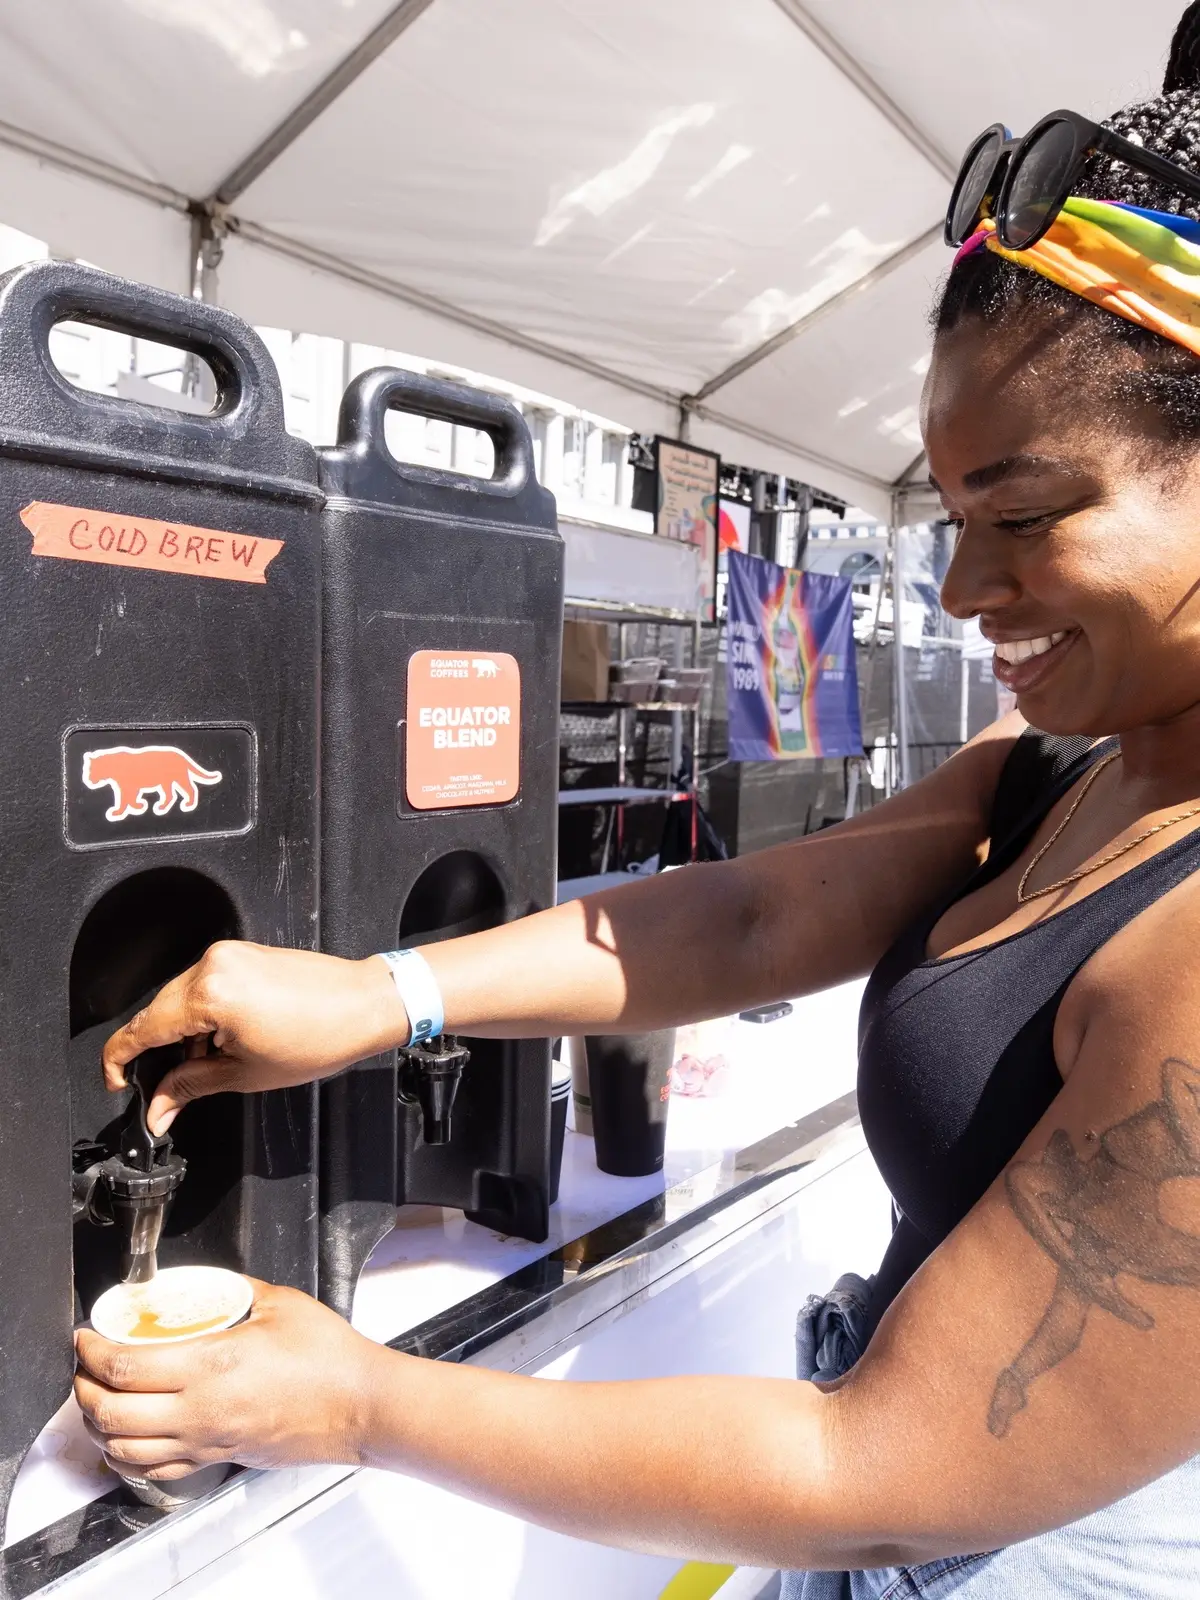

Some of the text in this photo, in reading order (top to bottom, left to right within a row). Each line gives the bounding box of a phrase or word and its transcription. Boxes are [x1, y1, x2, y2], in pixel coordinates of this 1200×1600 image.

[69, 519, 259, 568] COLD BREW
[430, 659, 469, 668] EQUATOR
[430, 669, 469, 678] COFFEES
[419, 706, 511, 728] EQUATOR
[433, 727, 497, 749] BLEND
